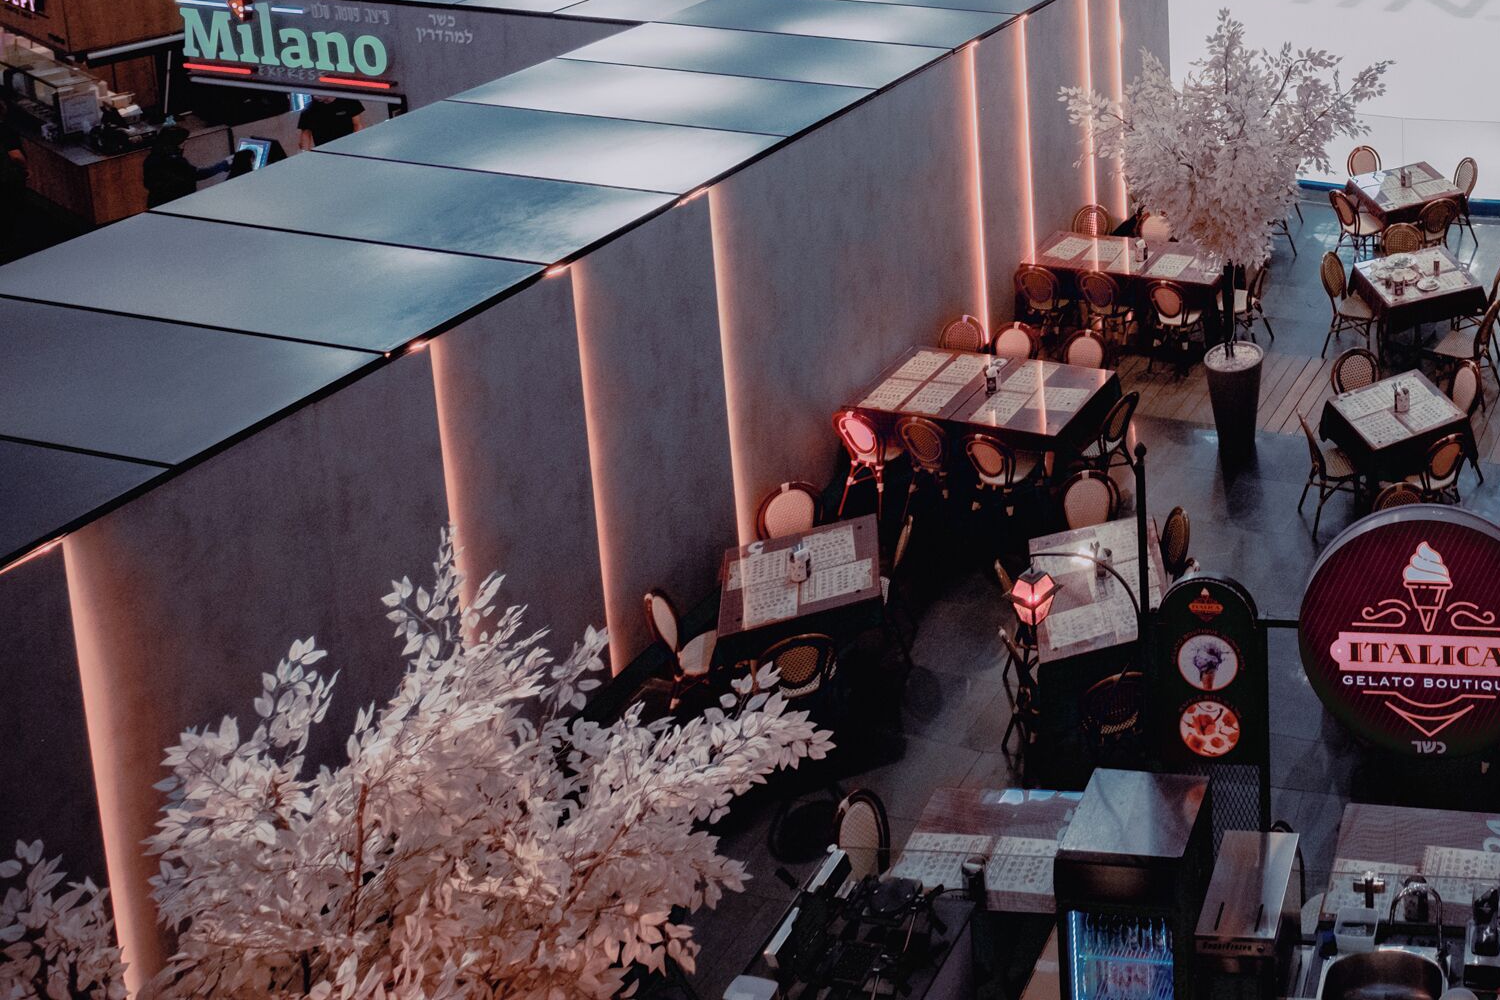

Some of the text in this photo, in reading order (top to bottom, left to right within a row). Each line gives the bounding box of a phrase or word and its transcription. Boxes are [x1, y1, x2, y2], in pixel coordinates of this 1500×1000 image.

[428, 13, 456, 27] כשר
[180, 2, 388, 77] Milano
[415, 27, 474, 44] למהדרין
[1342, 675, 1415, 688] GELATO
[1411, 740, 1448, 755] כשר
